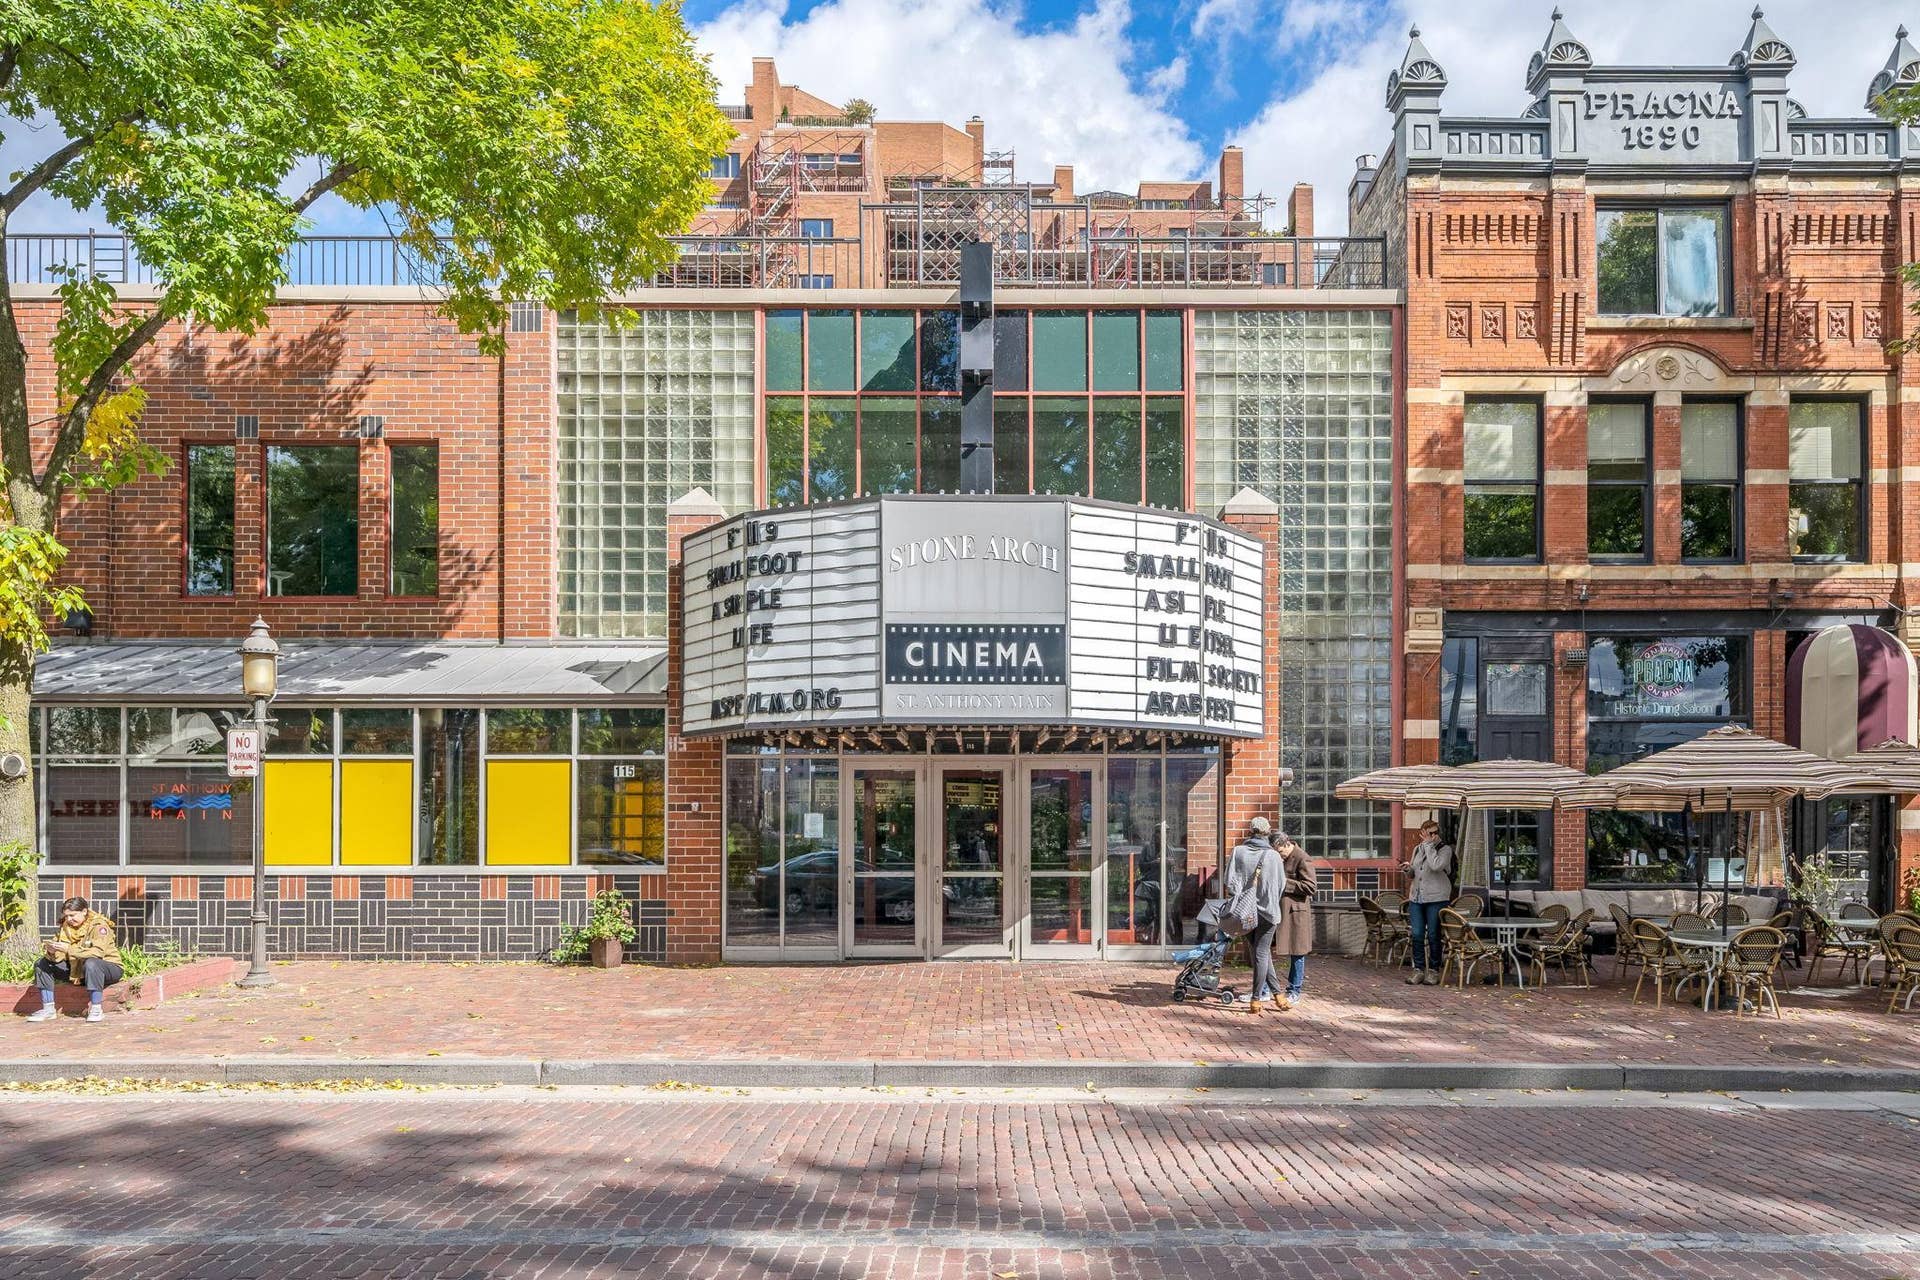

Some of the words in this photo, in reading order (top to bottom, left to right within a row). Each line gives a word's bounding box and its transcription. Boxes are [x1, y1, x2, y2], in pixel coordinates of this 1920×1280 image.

[1584, 90, 1742, 120] PRACNA
[1621, 126, 1701, 150] 1890
[747, 551, 802, 576] FOOT
[890, 534, 976, 573] STONE
[983, 535, 1060, 574] ARCH
[1124, 550, 1200, 582] SMALL
[1144, 589, 1160, 611] A
[906, 642, 1044, 667] CINEMA
[1146, 656, 1198, 683] FILM
[1208, 664, 1259, 695] SOCIETY
[1633, 659, 1694, 682] PRACNA
[896, 694, 918, 709] ST.
[923, 694, 1007, 710] ANTHONY
[1011, 694, 1054, 710] MAIN
[1648, 685, 1660, 697] ON
[1662, 685, 1683, 698] MAIN
[1145, 691, 1202, 717] ARAB
[1206, 696, 1236, 723] FEST
[236, 737, 250, 748] NO
[229, 752, 256, 761] PARKING
[616, 766, 633, 776] 115
[152, 784, 163, 794] ST
[171, 784, 232, 794] ANTHONY
[151, 810, 232, 820] MAIN
